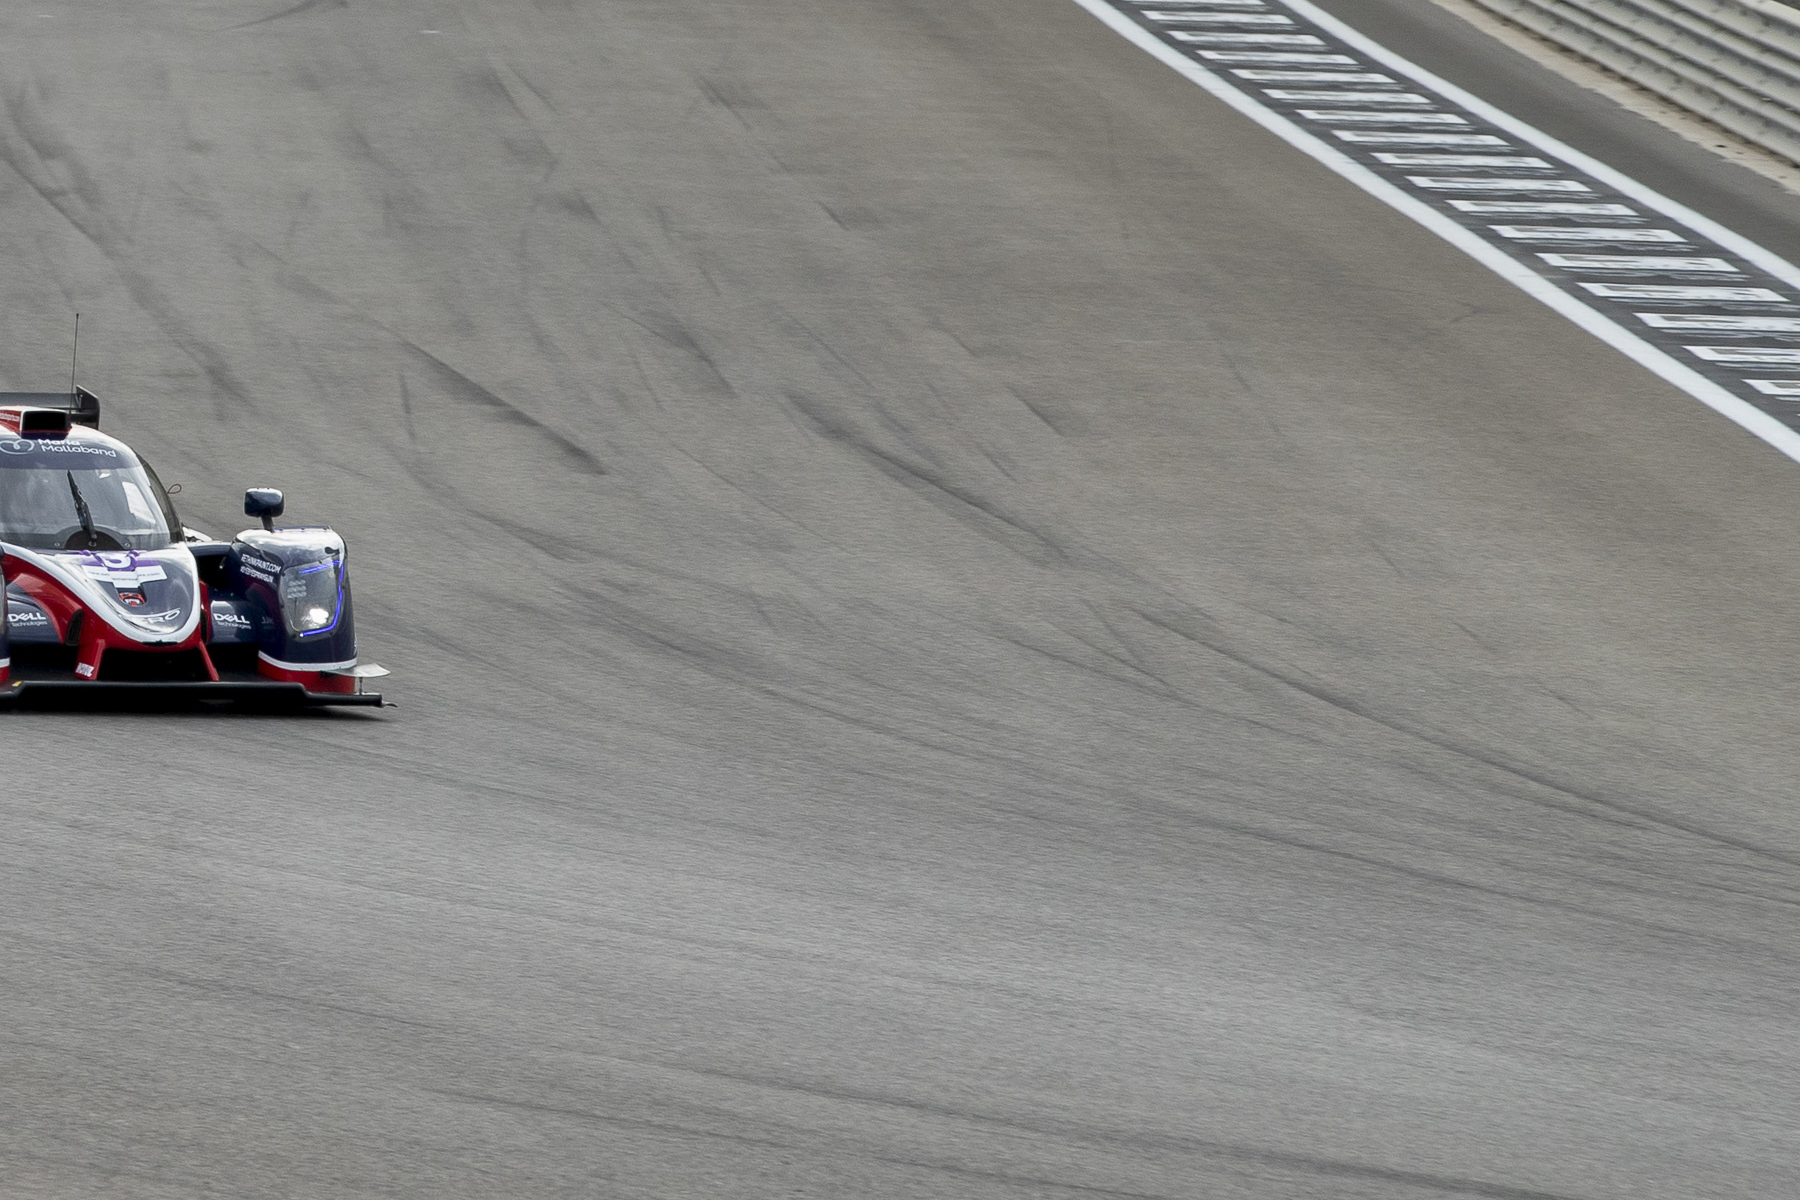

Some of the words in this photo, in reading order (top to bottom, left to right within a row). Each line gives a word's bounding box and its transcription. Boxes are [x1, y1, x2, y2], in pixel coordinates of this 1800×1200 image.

[41, 445, 117, 458] Mallaband
[8, 612, 47, 622] DELL
[213, 613, 251, 624] DELL
[217, 621, 252, 630] Technologies
